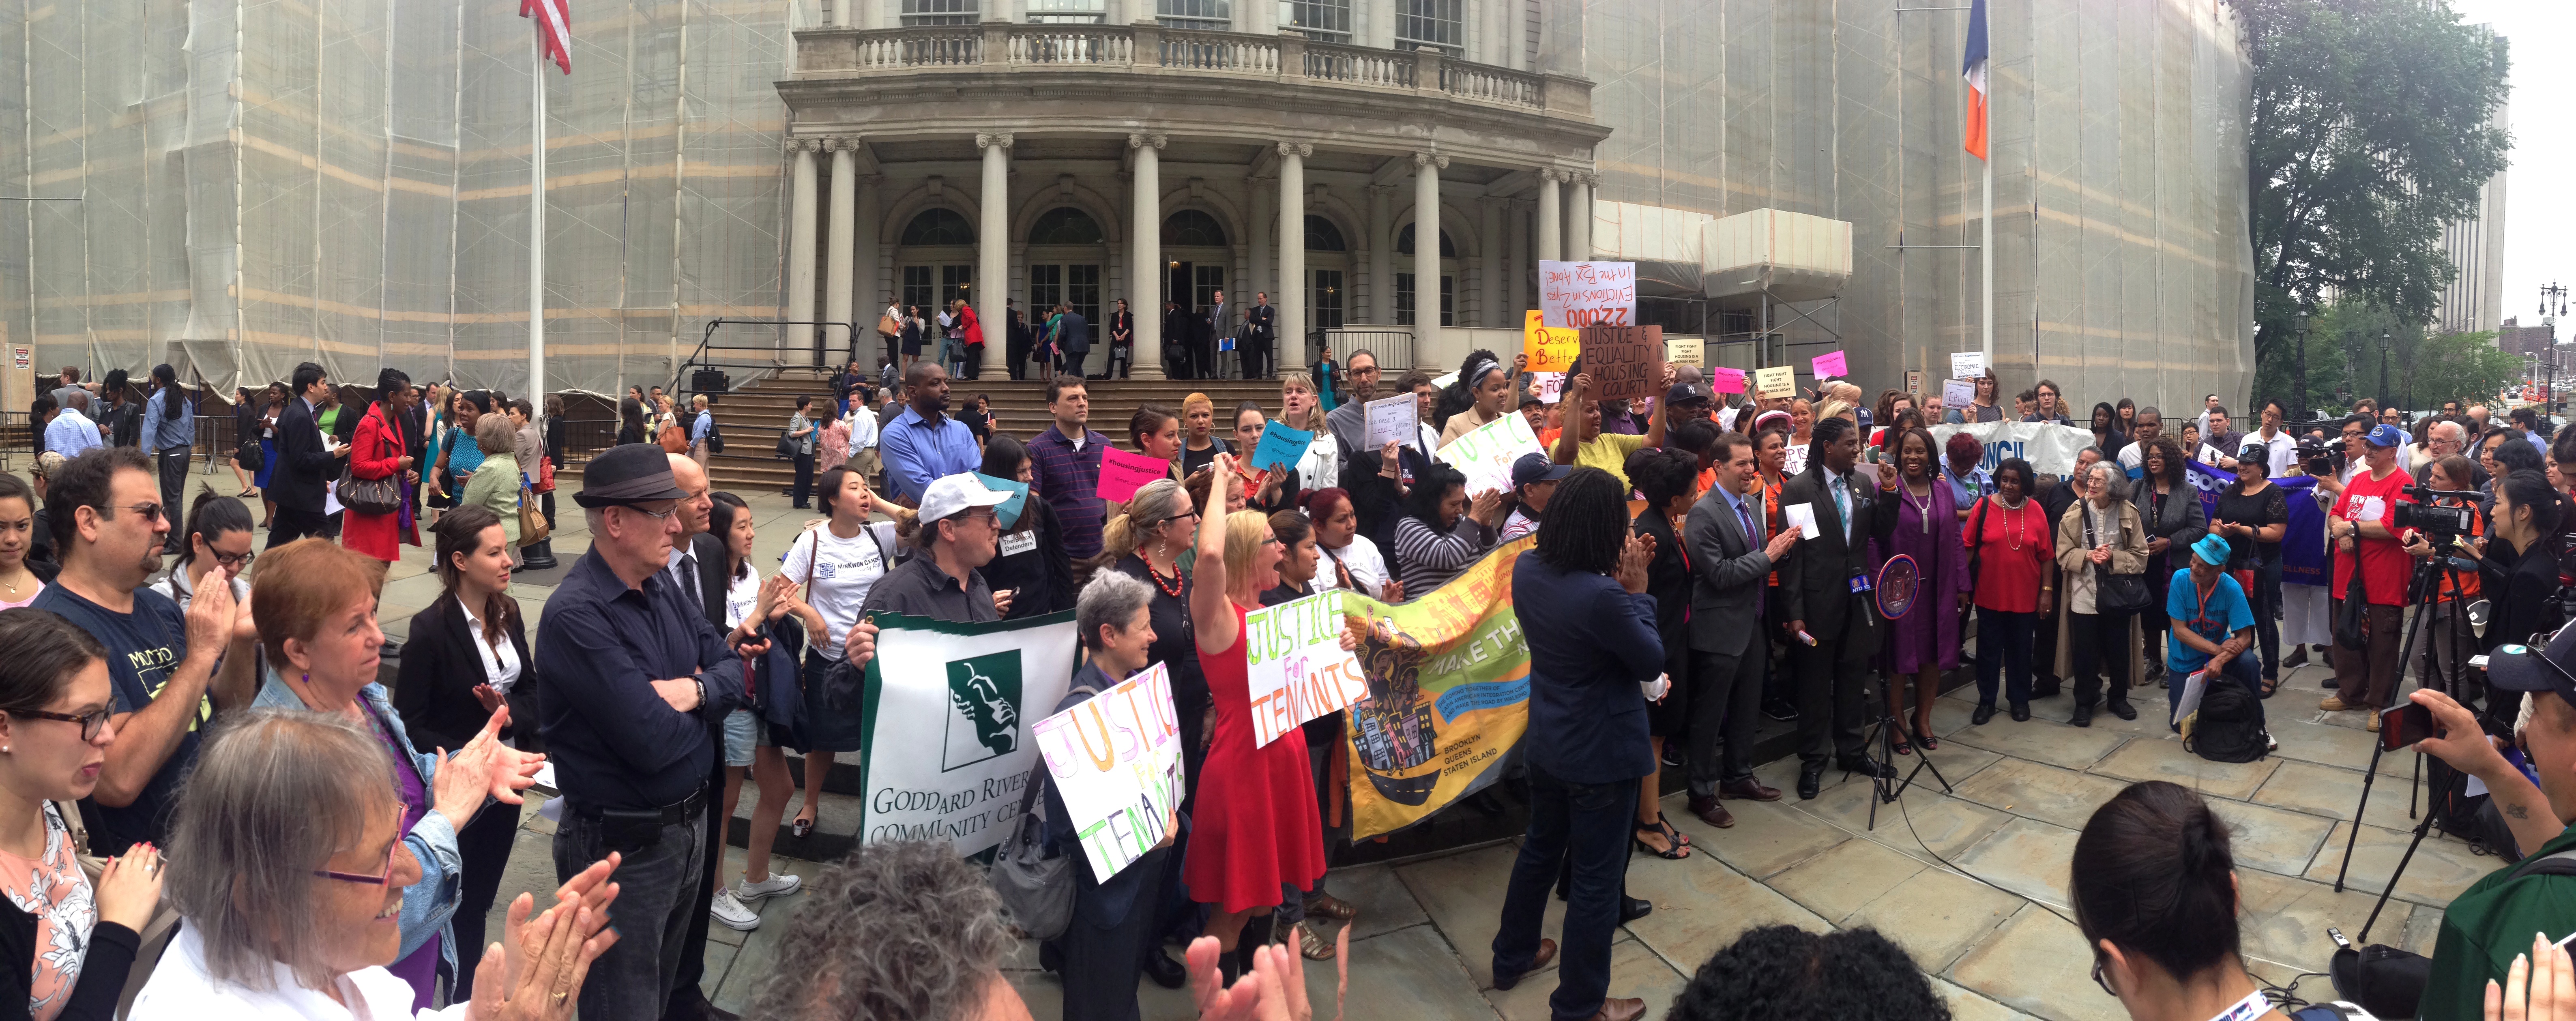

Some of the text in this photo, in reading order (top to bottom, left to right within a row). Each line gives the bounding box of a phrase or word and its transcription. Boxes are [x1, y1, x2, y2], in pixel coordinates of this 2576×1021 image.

[1599, 269, 1616, 281] the
[1561, 293, 1571, 308] 2
[1567, 305, 1627, 328] 22,000
[1535, 328, 1580, 345] Deserv
[1585, 326, 1647, 345] JUSTICE &
[1586, 344, 1664, 365] EQUALITY IN
[1594, 362, 1649, 382] HOUSING
[1603, 379, 1648, 396] COURT!
[1949, 392, 1969, 404] Ethical
[1388, 399, 1411, 407] #right2counsel
[1396, 422, 1411, 431] playing
[1108, 458, 1161, 475] #housingjustice
[1114, 475, 1147, 487] @met_coun
[2186, 468, 2230, 494] BOO
[1005, 541, 1033, 551] Defenders
[2283, 564, 2321, 575] ELLNESS
[1247, 590, 1344, 665] JUSTICE
[1427, 639, 1488, 676] MAKE
[1485, 618, 1521, 649] TH
[1284, 656, 1309, 685] For
[1251, 657, 1369, 745] TENANTS
[1438, 699, 1447, 708] THE
[1446, 689, 1464, 700] COMING
[1442, 681, 1531, 714] LATIN AMERICAN INTEGRATION CENTE
[1446, 709, 1455, 719] AND
[1455, 701, 1469, 710] MAKE
[1503, 691, 1527, 702] WALKING
[1032, 663, 1180, 779] JUSTICE
[1444, 734, 1481, 755] BROOKLYN
[1444, 748, 1497, 776] STATEN ISLAND
[1445, 748, 1472, 765] QUEENS
[1132, 750, 1161, 789] For
[874, 788, 975, 815] GODDARD
[1078, 752, 1185, 876] TENANTS
[871, 811, 992, 847] COMMUNITY
